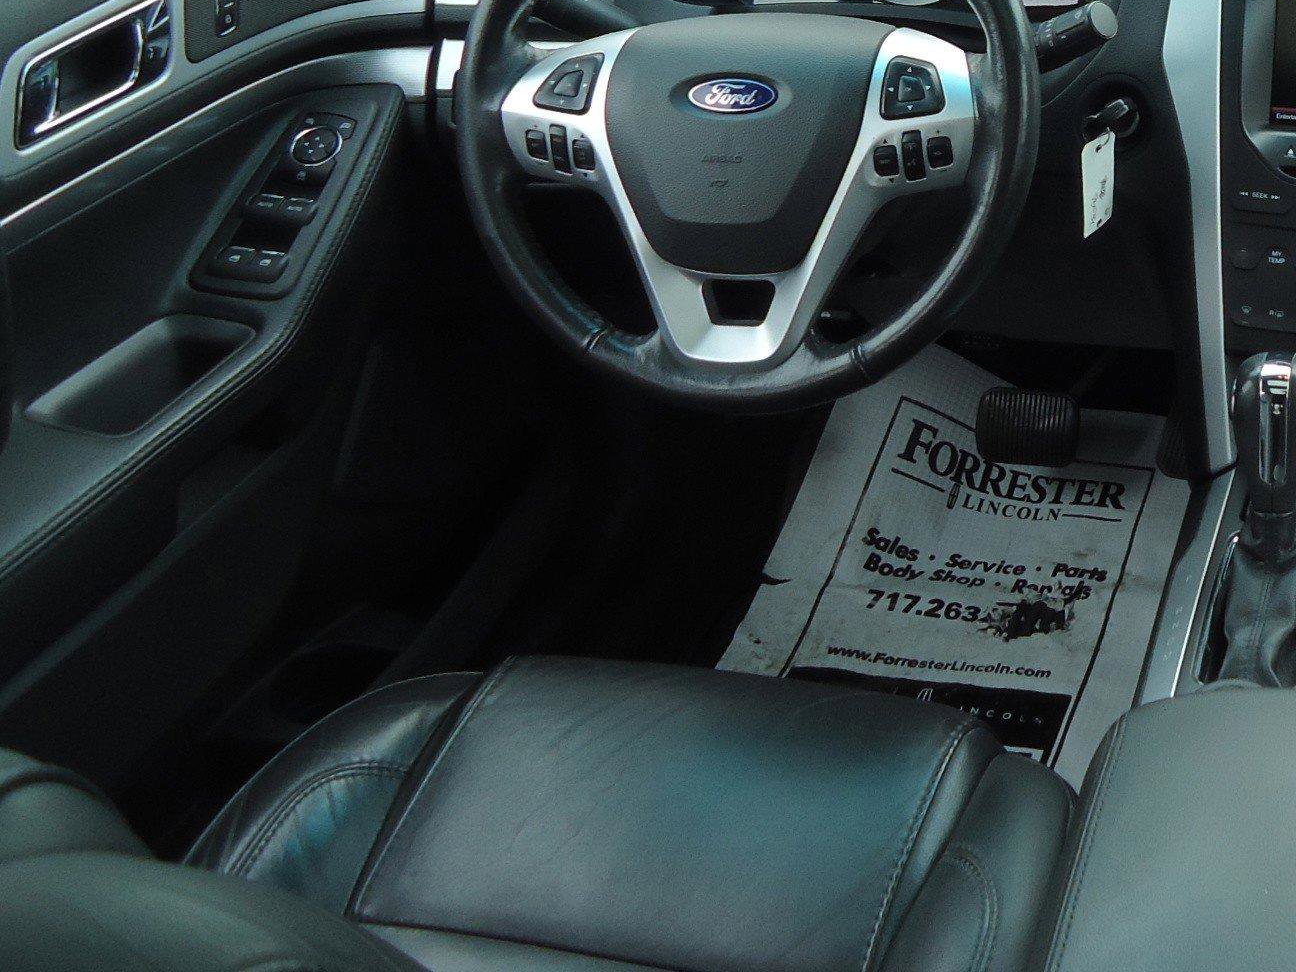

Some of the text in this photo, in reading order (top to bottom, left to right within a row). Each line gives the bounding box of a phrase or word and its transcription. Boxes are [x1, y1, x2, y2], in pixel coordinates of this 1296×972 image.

[704, 83, 757, 105] Ford
[897, 418, 1127, 510] FORRESTER
[962, 494, 1062, 521] LINCOLN
[862, 552, 925, 581] Body
[928, 568, 986, 588] Shop
[864, 527, 1108, 582] Sales Service Parts
[827, 645, 1052, 678] www.ForresterLincoln.com
